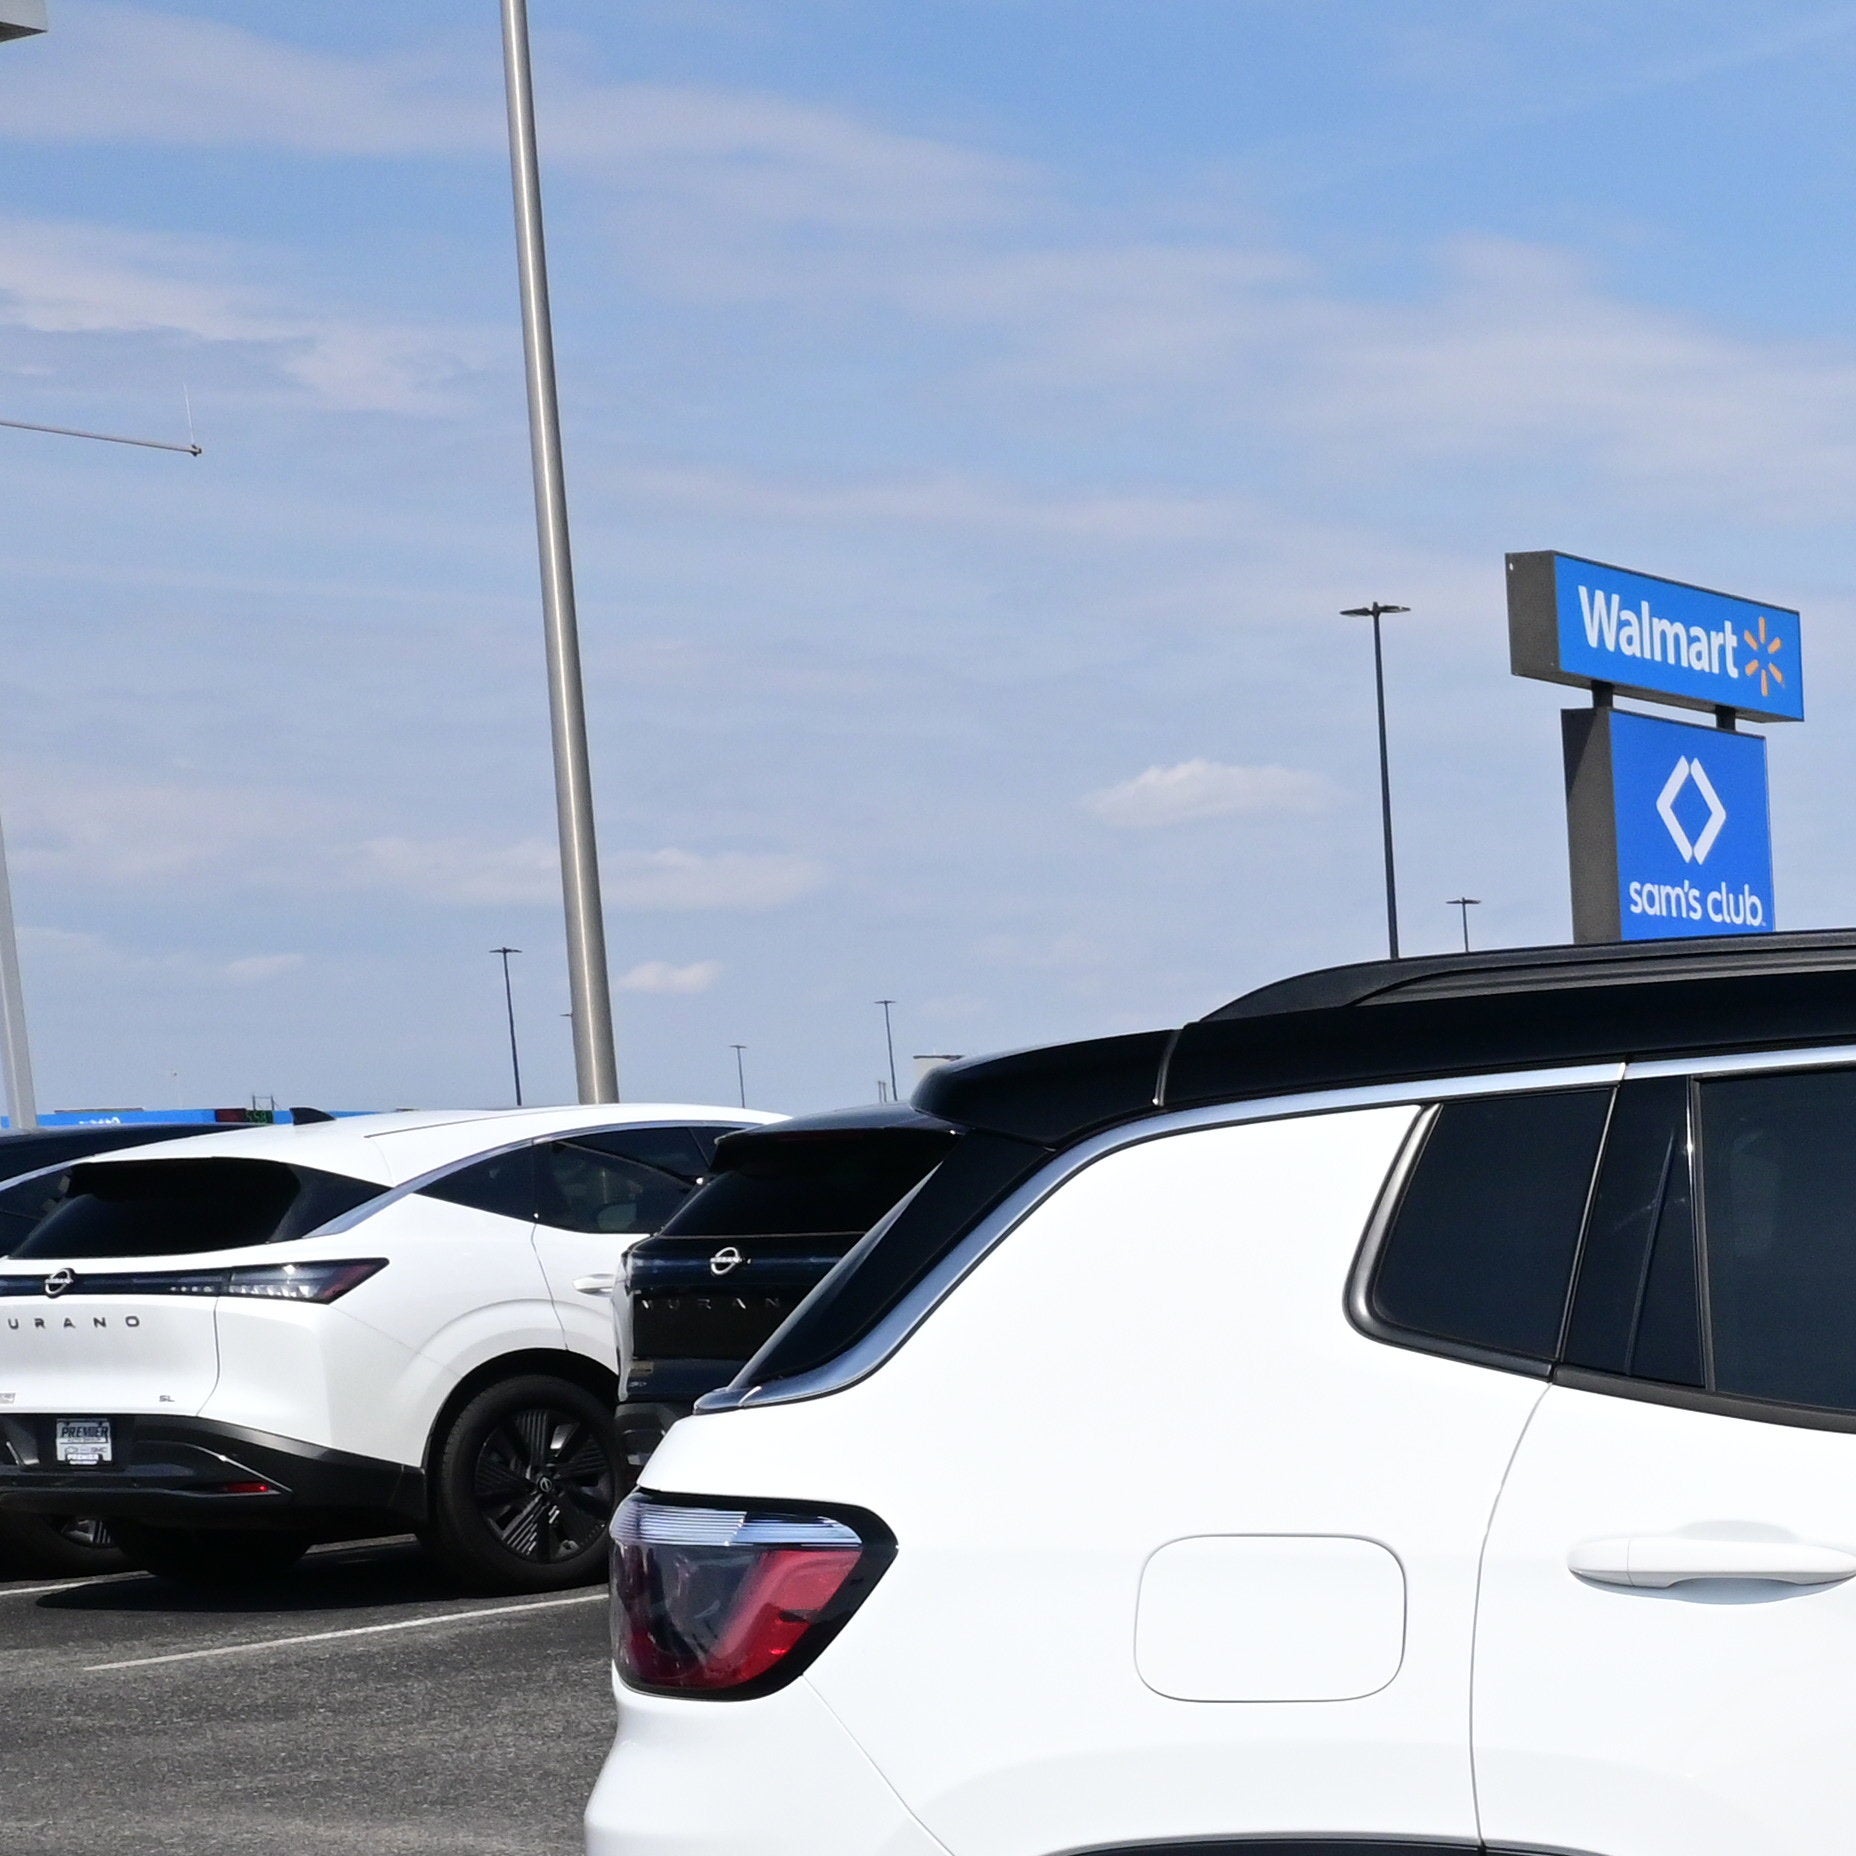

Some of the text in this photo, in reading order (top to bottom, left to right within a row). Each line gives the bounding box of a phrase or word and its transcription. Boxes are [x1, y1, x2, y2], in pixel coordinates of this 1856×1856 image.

[1577, 585, 1739, 679] Walmart
[1629, 879, 1763, 927] sam's club
